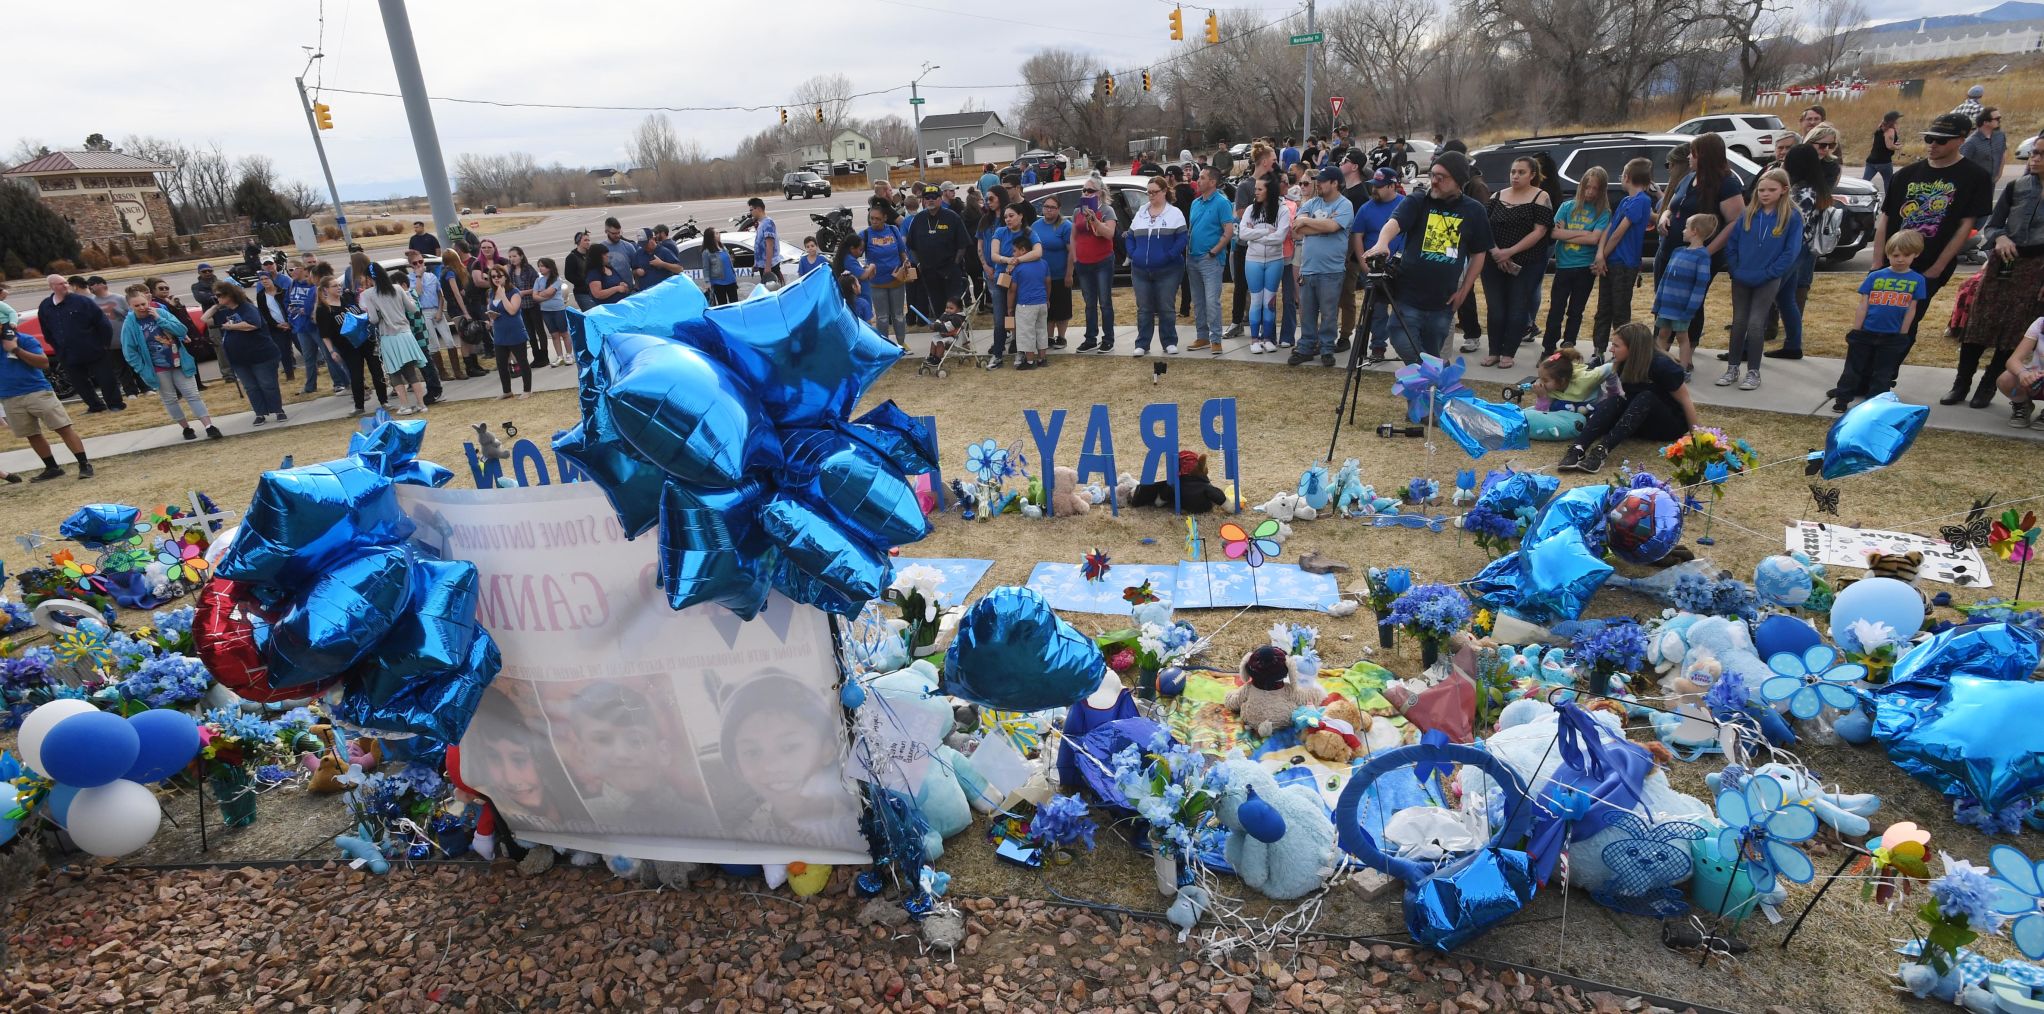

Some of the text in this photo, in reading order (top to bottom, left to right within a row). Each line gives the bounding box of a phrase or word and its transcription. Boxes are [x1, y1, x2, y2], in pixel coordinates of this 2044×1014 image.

[1873, 277, 1918, 293] BEST
[1868, 290, 1913, 307] BRO
[1923, 549, 1976, 562] YOU
